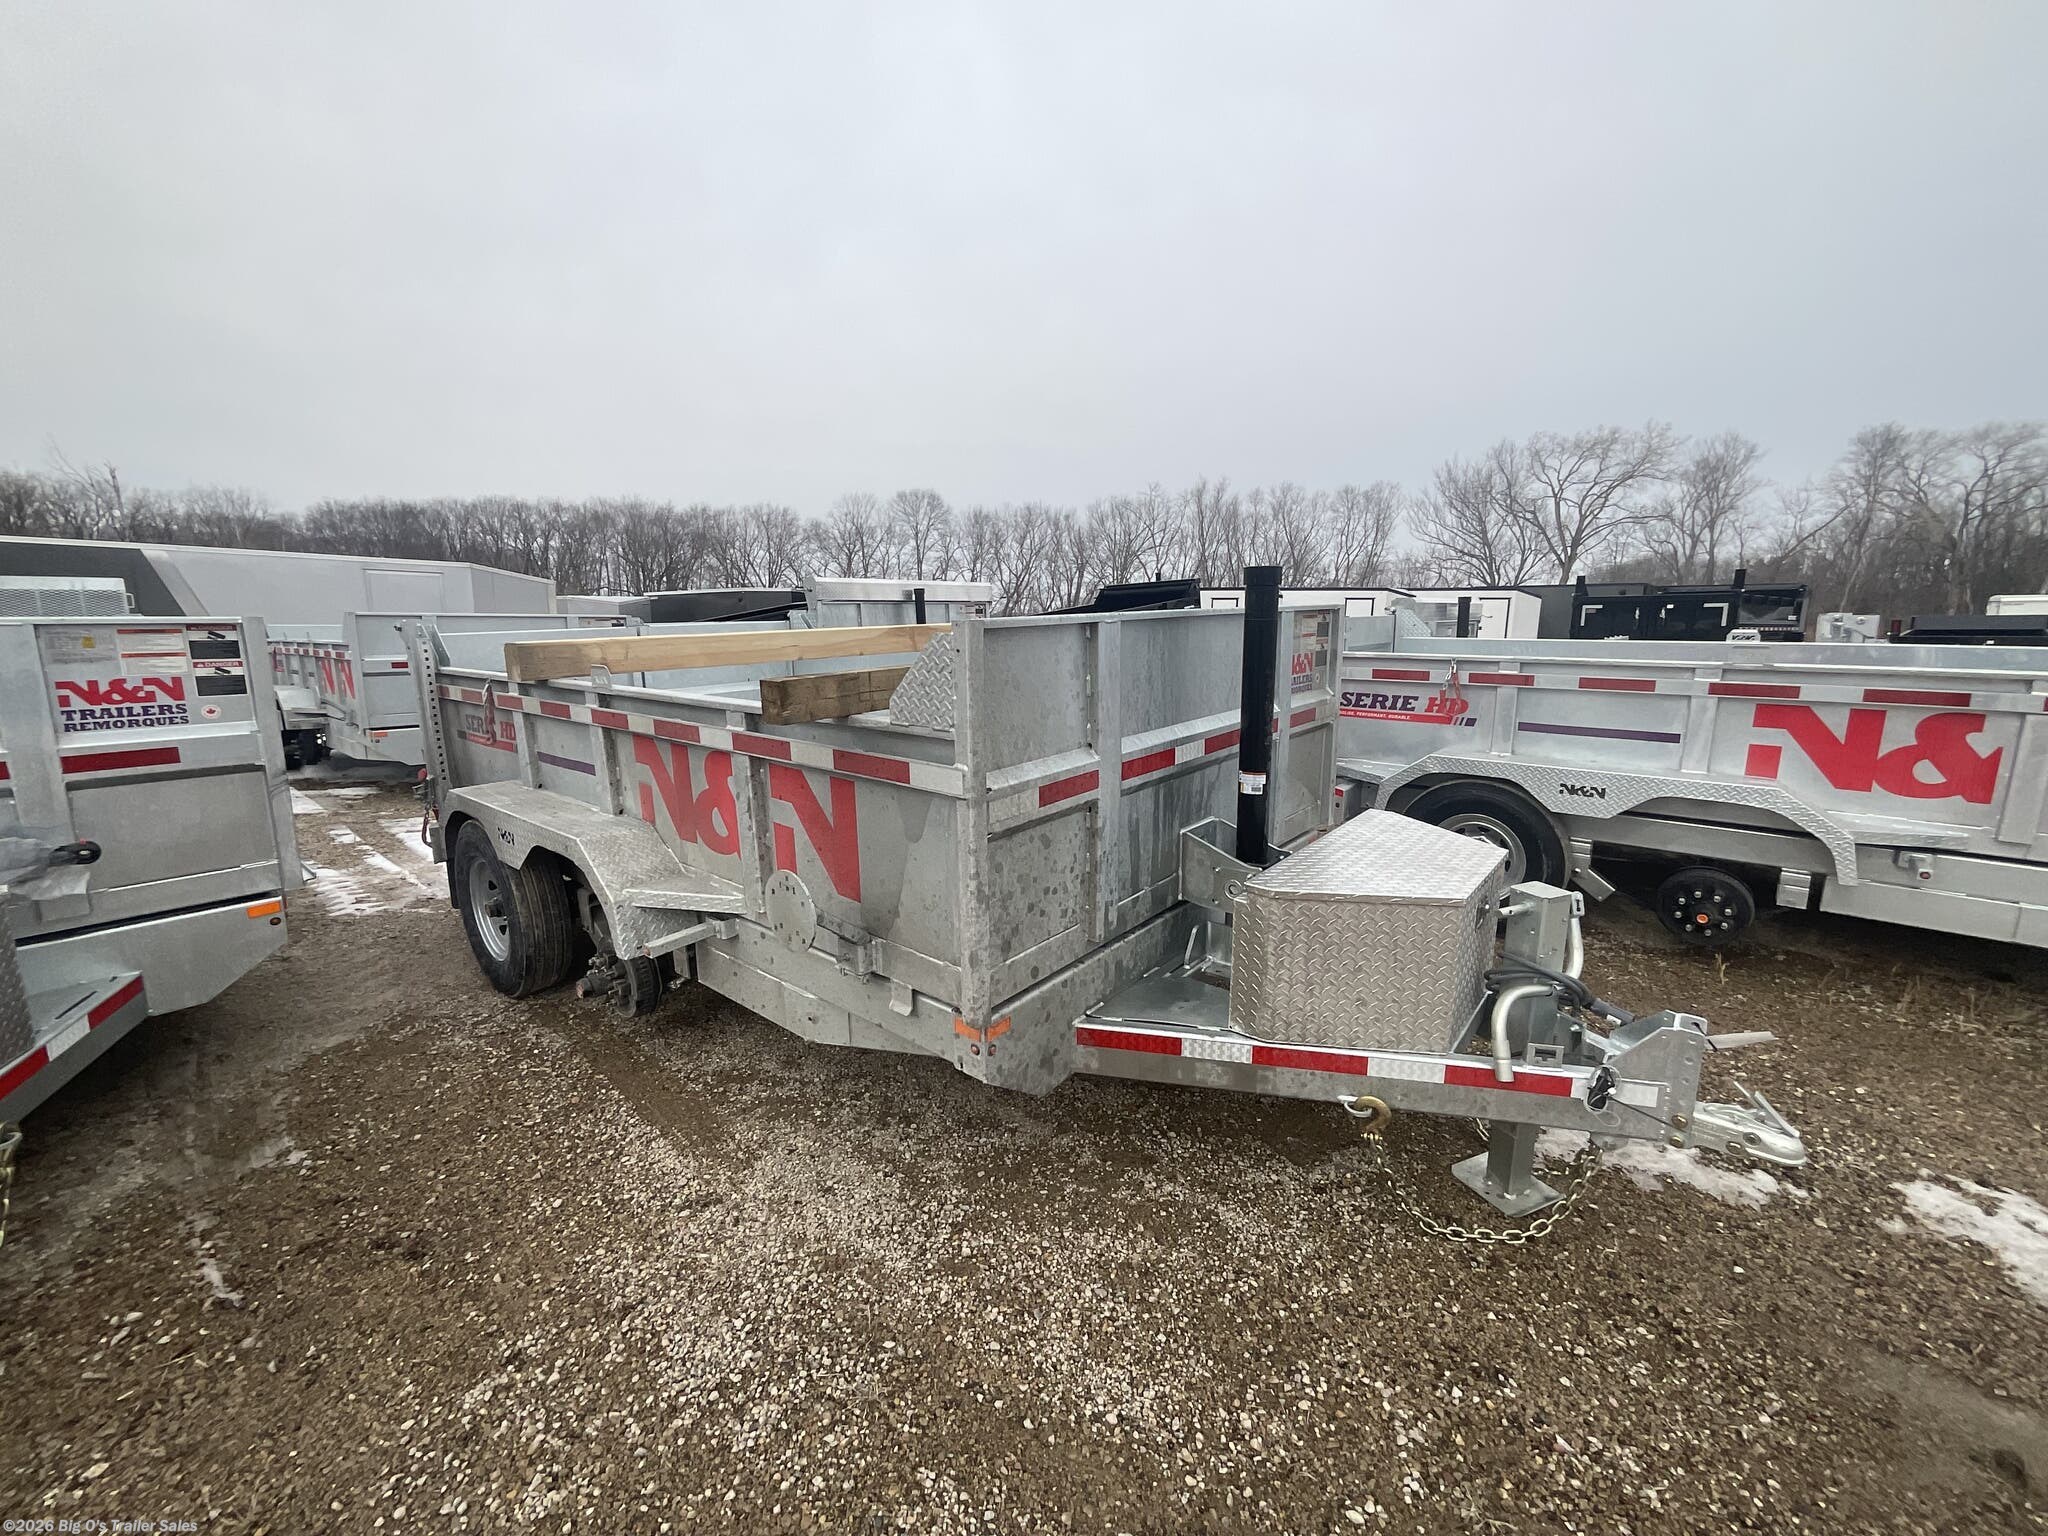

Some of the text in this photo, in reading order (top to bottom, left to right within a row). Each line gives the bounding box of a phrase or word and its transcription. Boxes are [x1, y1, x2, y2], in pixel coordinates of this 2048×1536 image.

[55, 676, 187, 708] N&N
[61, 703, 188, 722] TRAILERS
[1340, 691, 1469, 715] SERIE HD
[64, 716, 189, 733] REMORQUES
[1559, 783, 1606, 799] N&N
